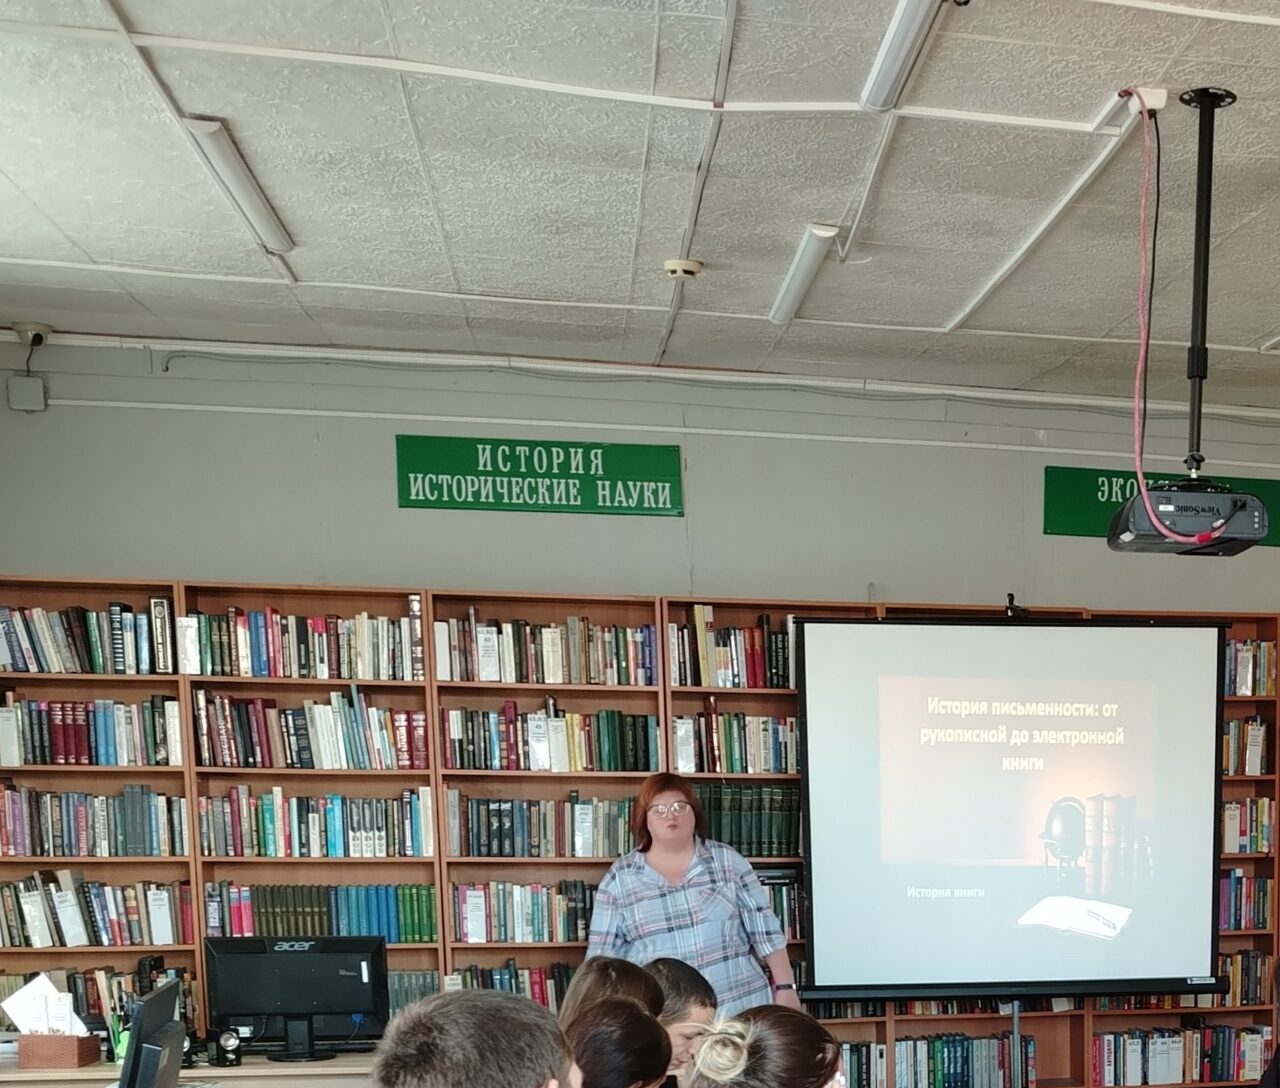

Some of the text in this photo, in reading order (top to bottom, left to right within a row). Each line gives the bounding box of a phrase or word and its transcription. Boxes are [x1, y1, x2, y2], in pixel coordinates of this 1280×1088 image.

[476, 444, 604, 475] ИСТОРИЯ
[408, 473, 672, 508] ИСТОРИЧЕСКИЕ НАУКИ
[1175, 505, 1222, 516] ViewSonic
[927, 697, 1118, 718] История письменности: от
[920, 725, 1125, 748] рукописной до электронной
[1002, 756, 1044, 771] книги
[907, 886, 985, 900] История книги
[274, 941, 316, 951] acer
